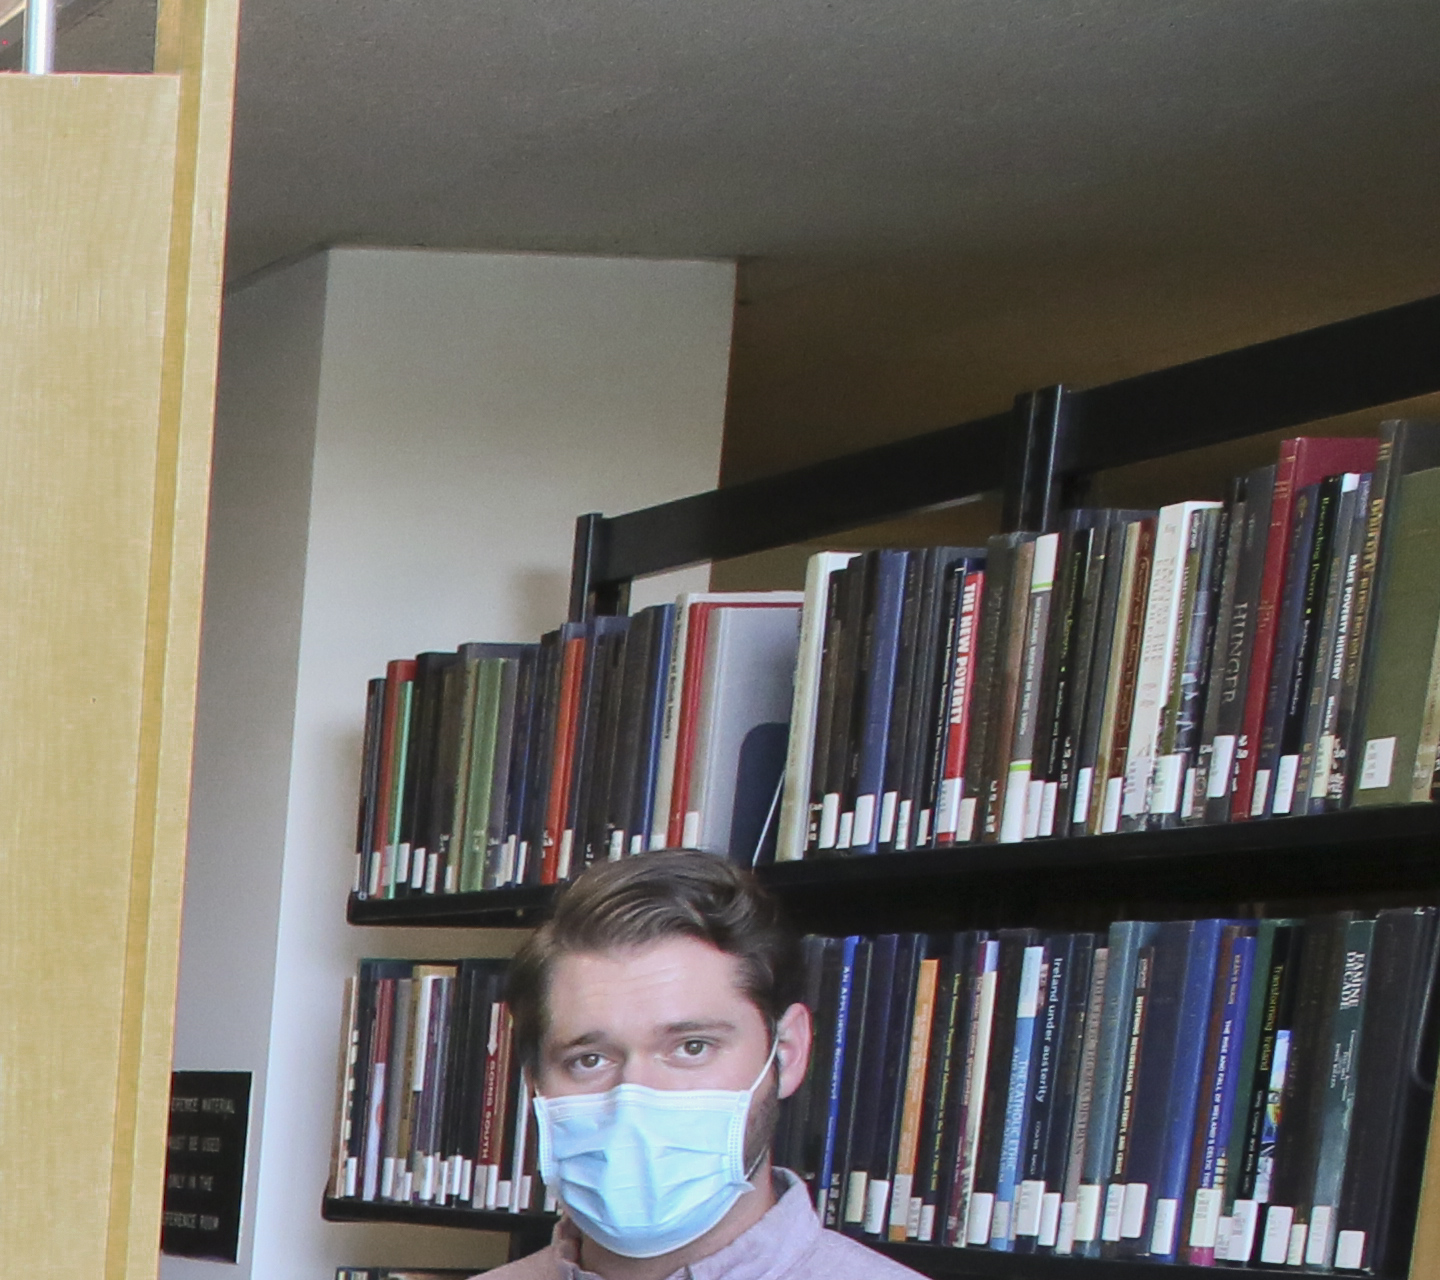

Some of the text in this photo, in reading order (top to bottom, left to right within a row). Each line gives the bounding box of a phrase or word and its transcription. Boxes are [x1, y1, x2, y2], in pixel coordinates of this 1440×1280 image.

[1331, 554, 1358, 680] MAKE POVERTY HISTORY
[950, 583, 976, 723] THE NEW POVERTY
[1221, 602, 1249, 705] HUNGER
[835, 965, 851, 1043] AN AFFLUENT
[1340, 952, 1357, 1010] DECADE
[1351, 953, 1366, 1007] FAMINE
[1035, 957, 1063, 1102] Ireland under austerity
[1221, 1036, 1231, 1053] RISE
[1222, 1019, 1233, 1034] THE
[1260, 966, 1283, 1071] Transforming Ireland
[1214, 1073, 1226, 1091] FALL
[1218, 1055, 1228, 1071] AND
[482, 1111, 492, 1158] SOUTH
[1007, 1060, 1027, 1171] THE CATHOLIC ETHIC
[199, 1175, 213, 1191] THE
